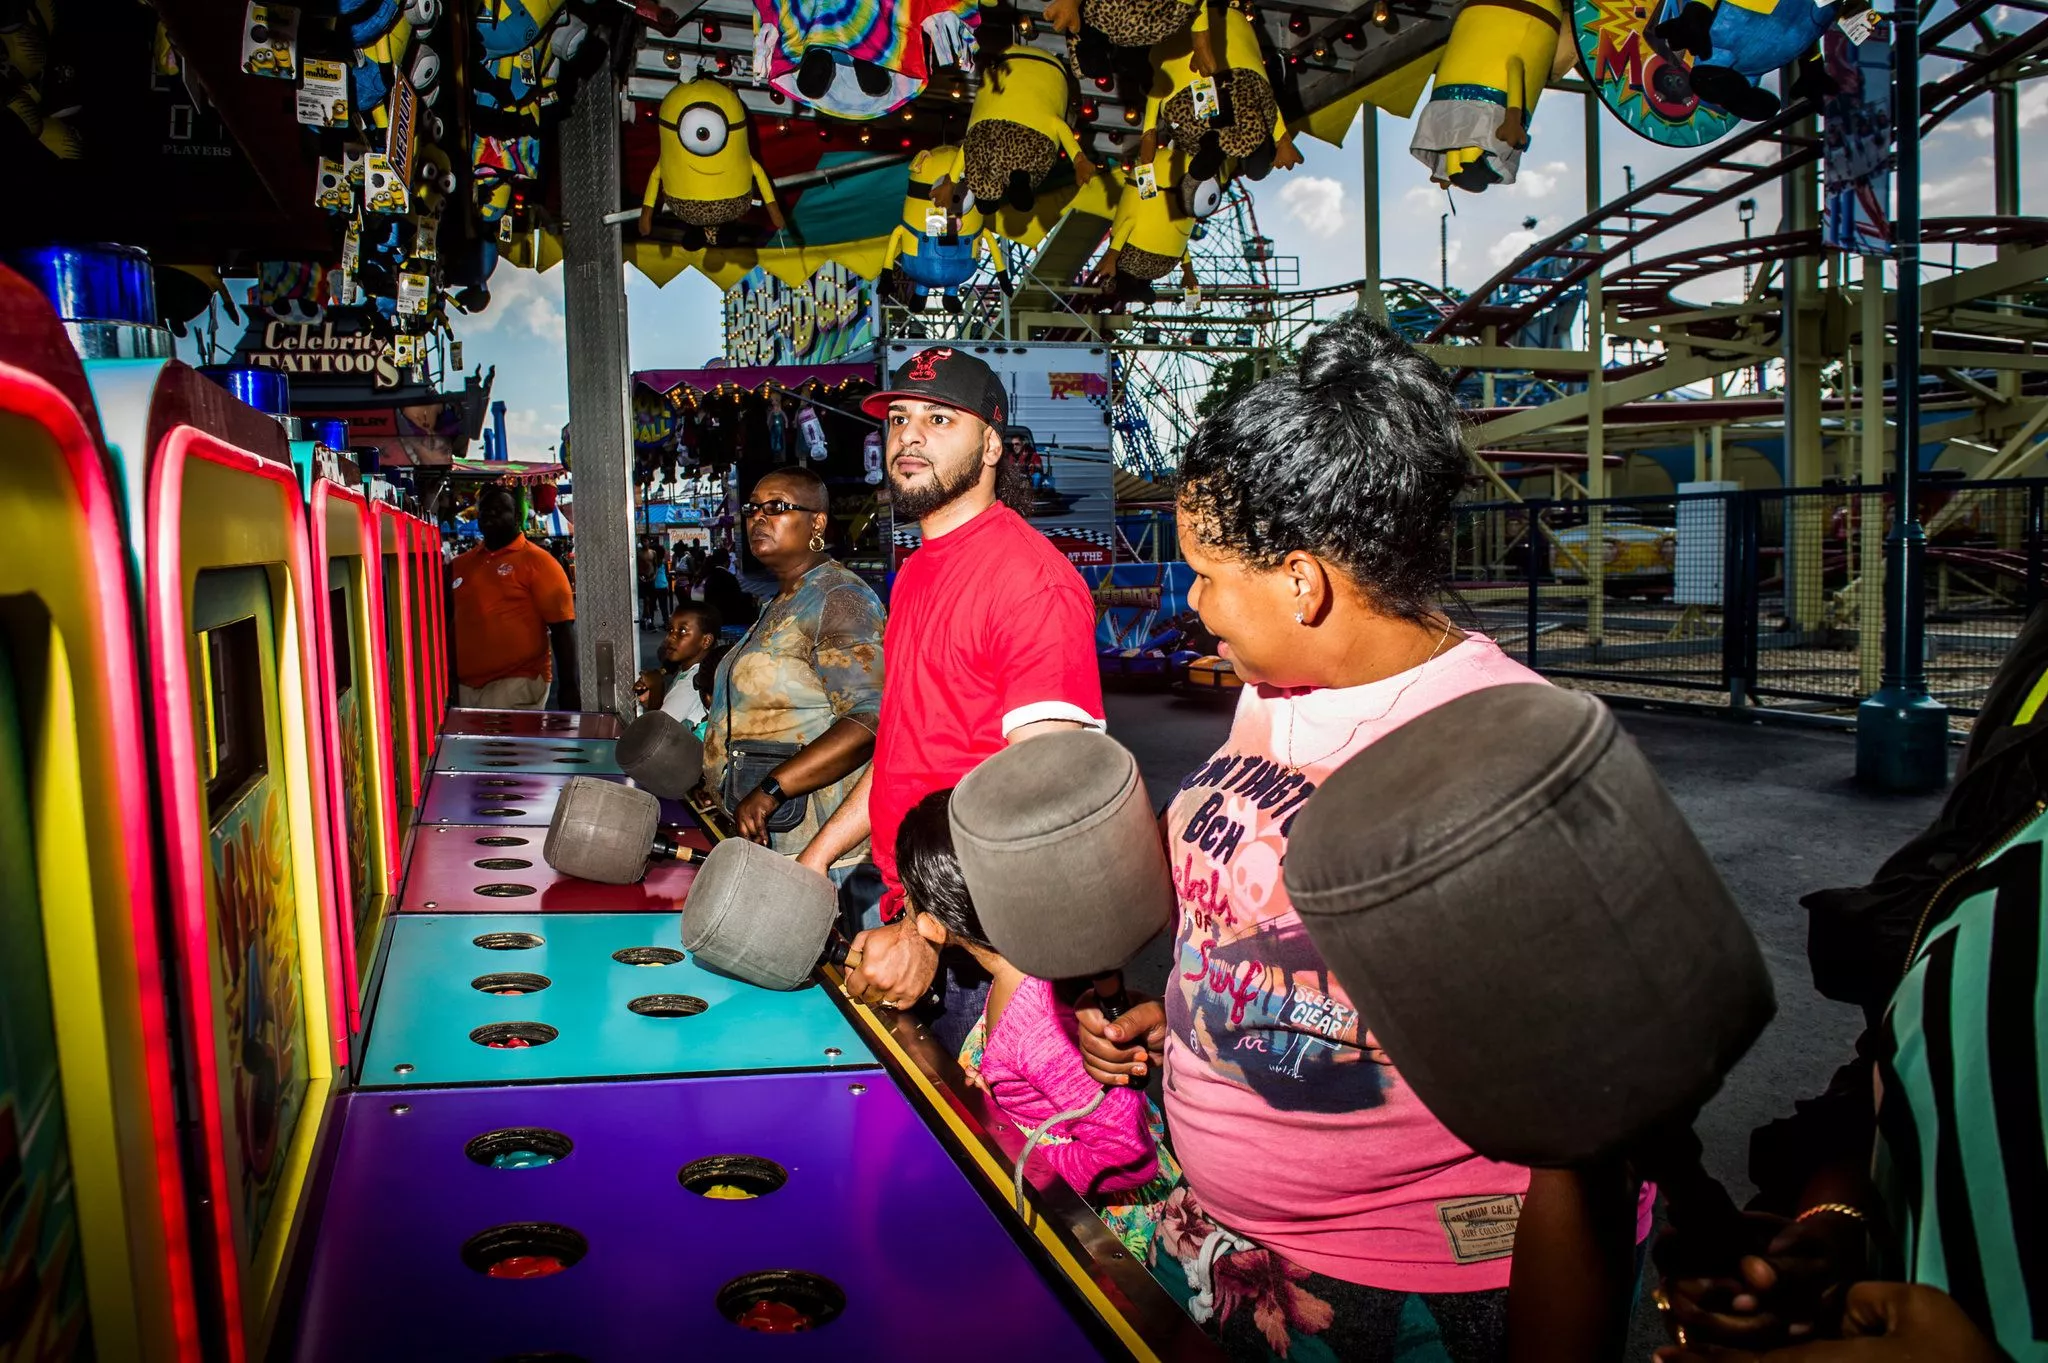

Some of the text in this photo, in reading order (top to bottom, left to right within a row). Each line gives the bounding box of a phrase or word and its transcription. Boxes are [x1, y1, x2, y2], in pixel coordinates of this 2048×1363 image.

[393, 79, 413, 178] MEDIUM
[161, 144, 232, 157] PLAYERS
[264, 320, 388, 356] Celebrity
[1082, 551, 1103, 562] THE
[1182, 792, 1245, 865] BCH
[1173, 853, 1238, 927] ebels
[1183, 939, 1262, 1024] Surf
[1290, 1003, 1343, 1039] CLEAR
[1450, 1206, 1488, 1222] PREMIUM
[1461, 1226, 1478, 1238] SURF
